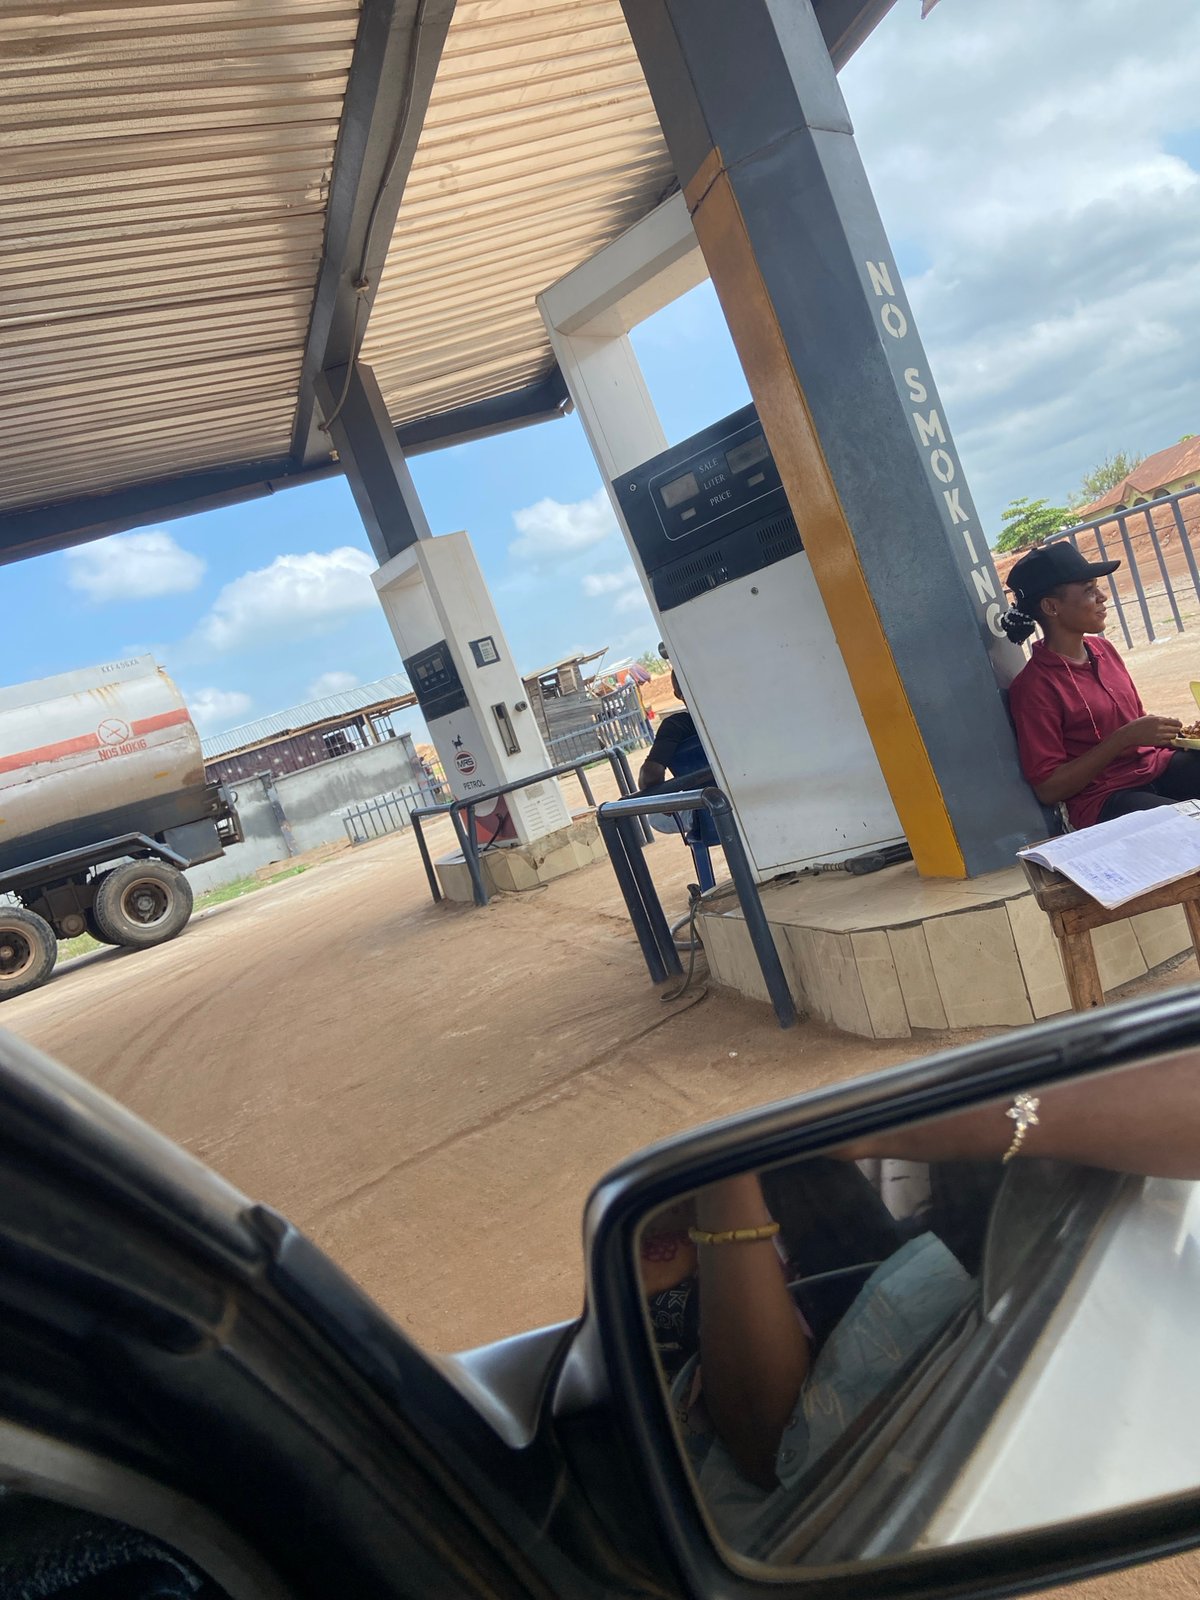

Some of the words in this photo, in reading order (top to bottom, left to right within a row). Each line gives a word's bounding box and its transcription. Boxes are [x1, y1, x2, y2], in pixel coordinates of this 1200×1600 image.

[865, 260, 908, 339] NO
[904, 367, 1008, 639] SMOKING
[699, 458, 719, 473] SALE
[703, 474, 726, 490] LITER
[709, 490, 732, 506] PRICE
[456, 758, 474, 769] MRS
[463, 779, 486, 791] PETROL
